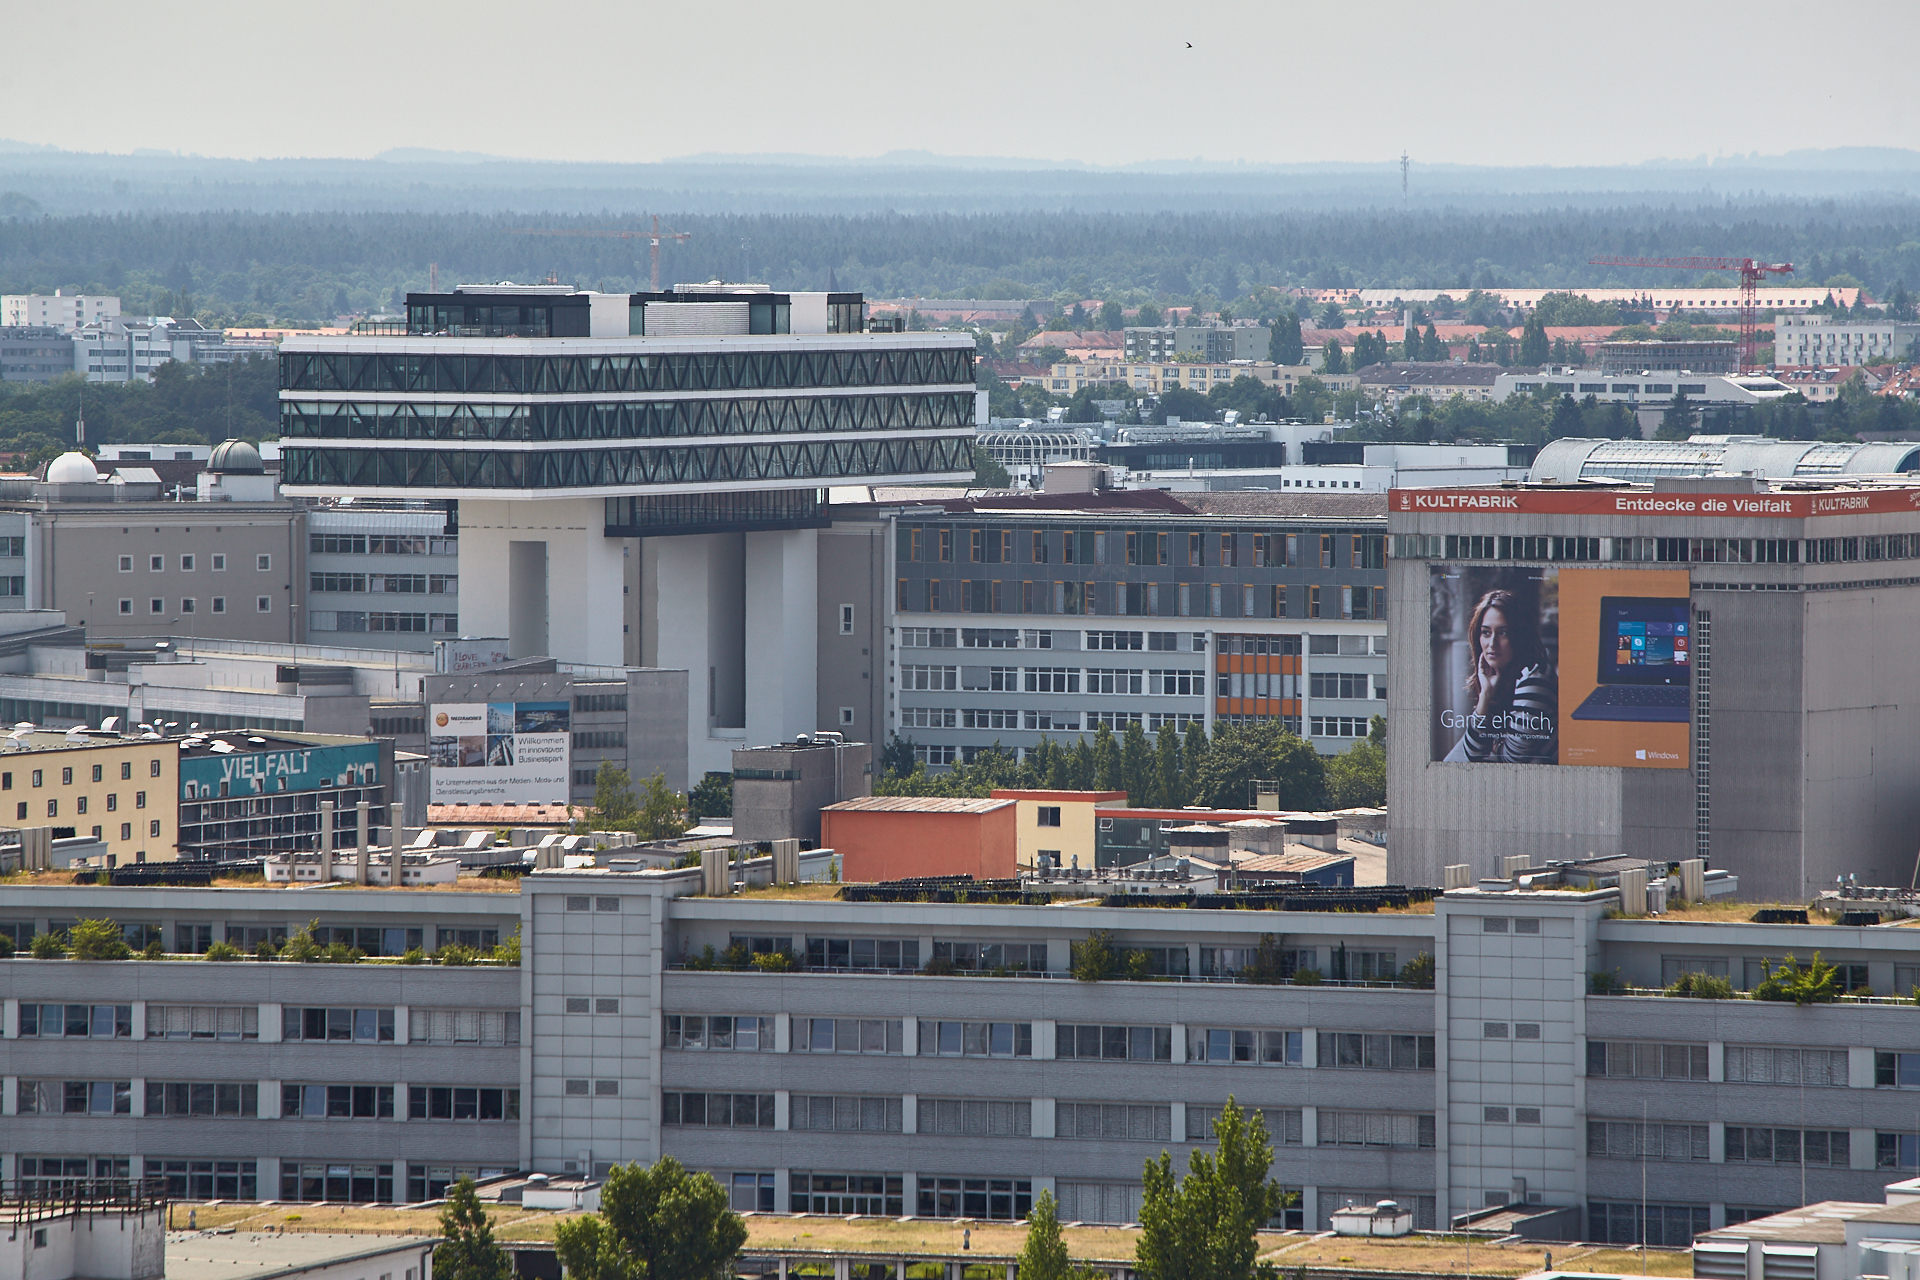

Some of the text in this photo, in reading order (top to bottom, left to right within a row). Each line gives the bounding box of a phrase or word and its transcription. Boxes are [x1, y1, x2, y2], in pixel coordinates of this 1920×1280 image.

[1416, 495, 1518, 508] KULTFABRIK
[1615, 497, 1792, 513] Entdecke die Vielfalt
[1819, 496, 1869, 511] KULTFABRIK
[458, 651, 478, 662] LOVE
[1440, 709, 1554, 733] Ganz ehrlich,
[518, 737, 565, 745] Willkommen
[518, 755, 564, 764] Businesspark
[1648, 751, 1679, 760] Windows
[222, 752, 310, 778] VIELFALT
